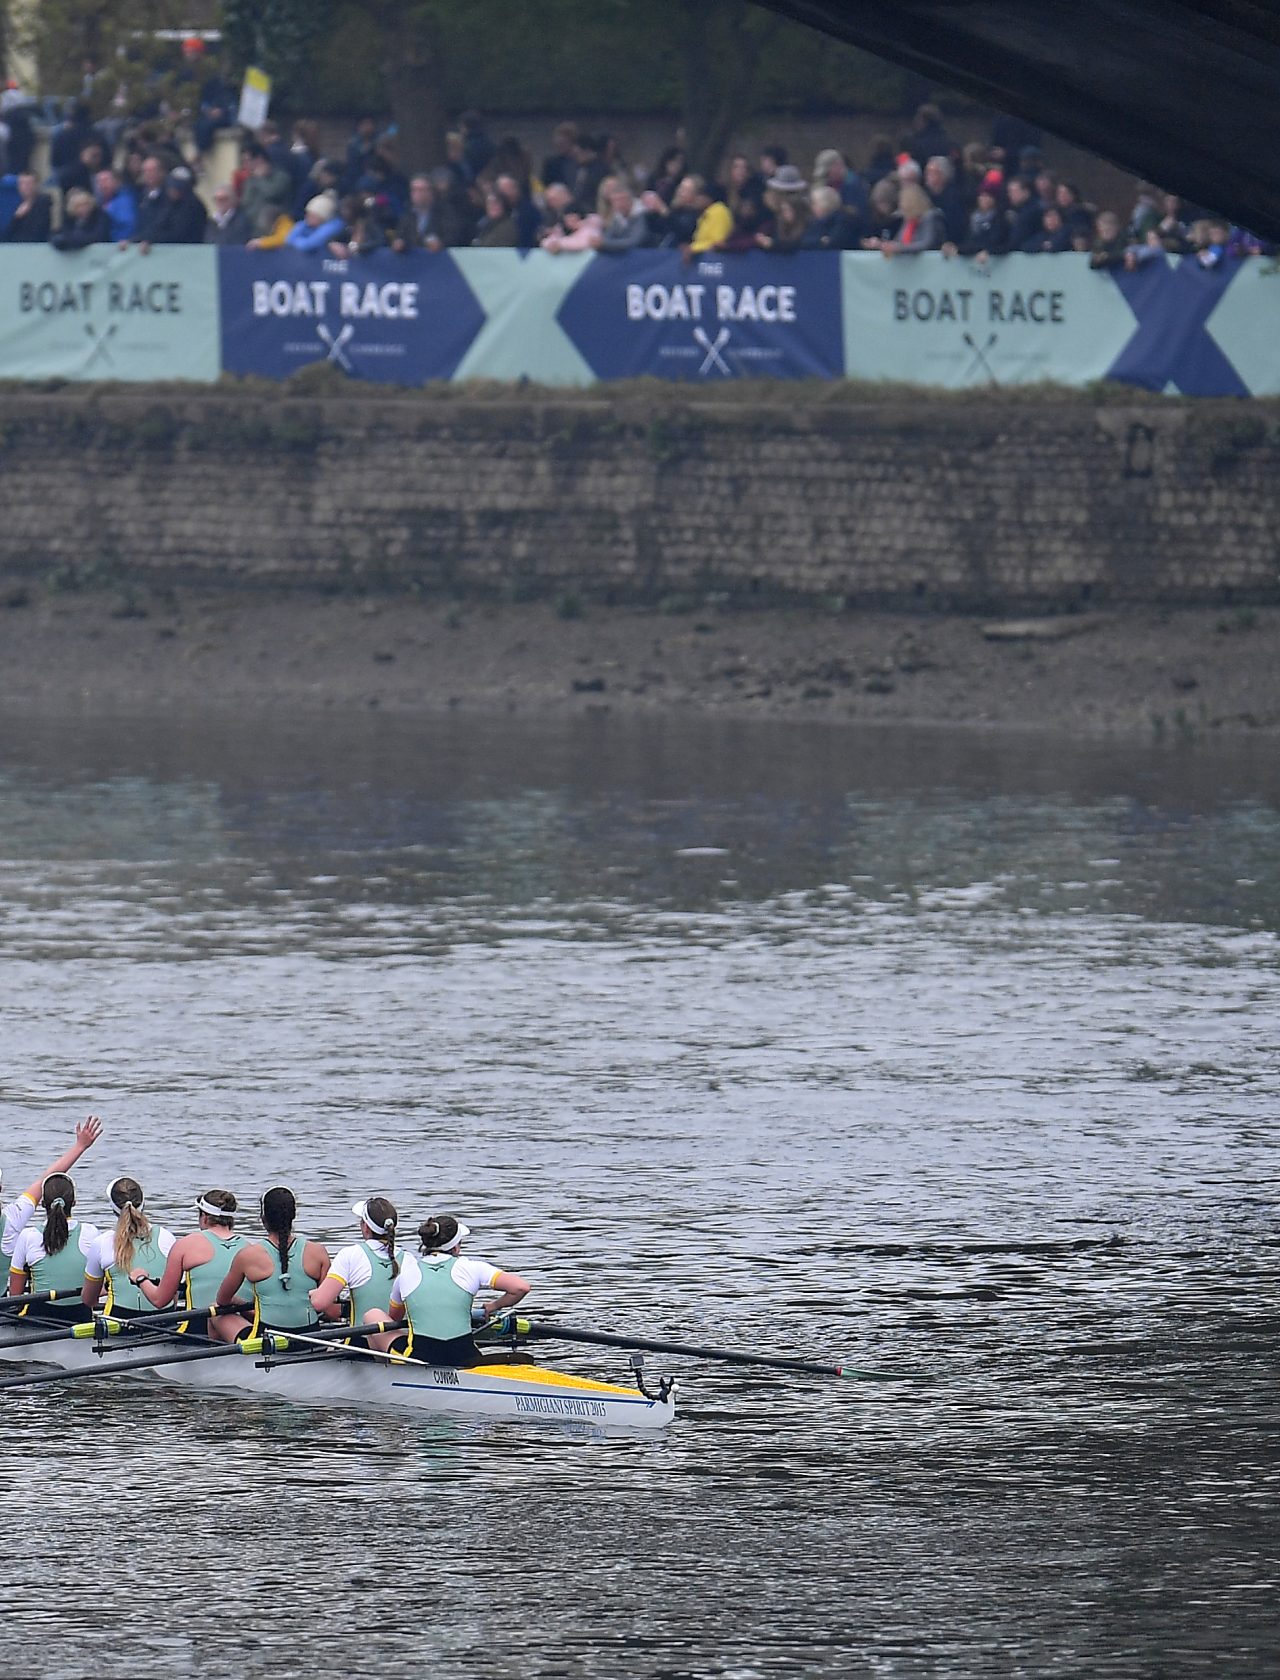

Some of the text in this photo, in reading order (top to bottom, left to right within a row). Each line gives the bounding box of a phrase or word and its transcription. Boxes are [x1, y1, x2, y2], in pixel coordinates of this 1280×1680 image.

[20, 281, 181, 314] BOAT RACE
[253, 280, 419, 318] BOAT RACE
[626, 284, 797, 322] BOAT RACE
[894, 289, 1065, 324] BOAT RACE
[515, 1396, 606, 1417] PARMIGIANI SPIRIT 2015
